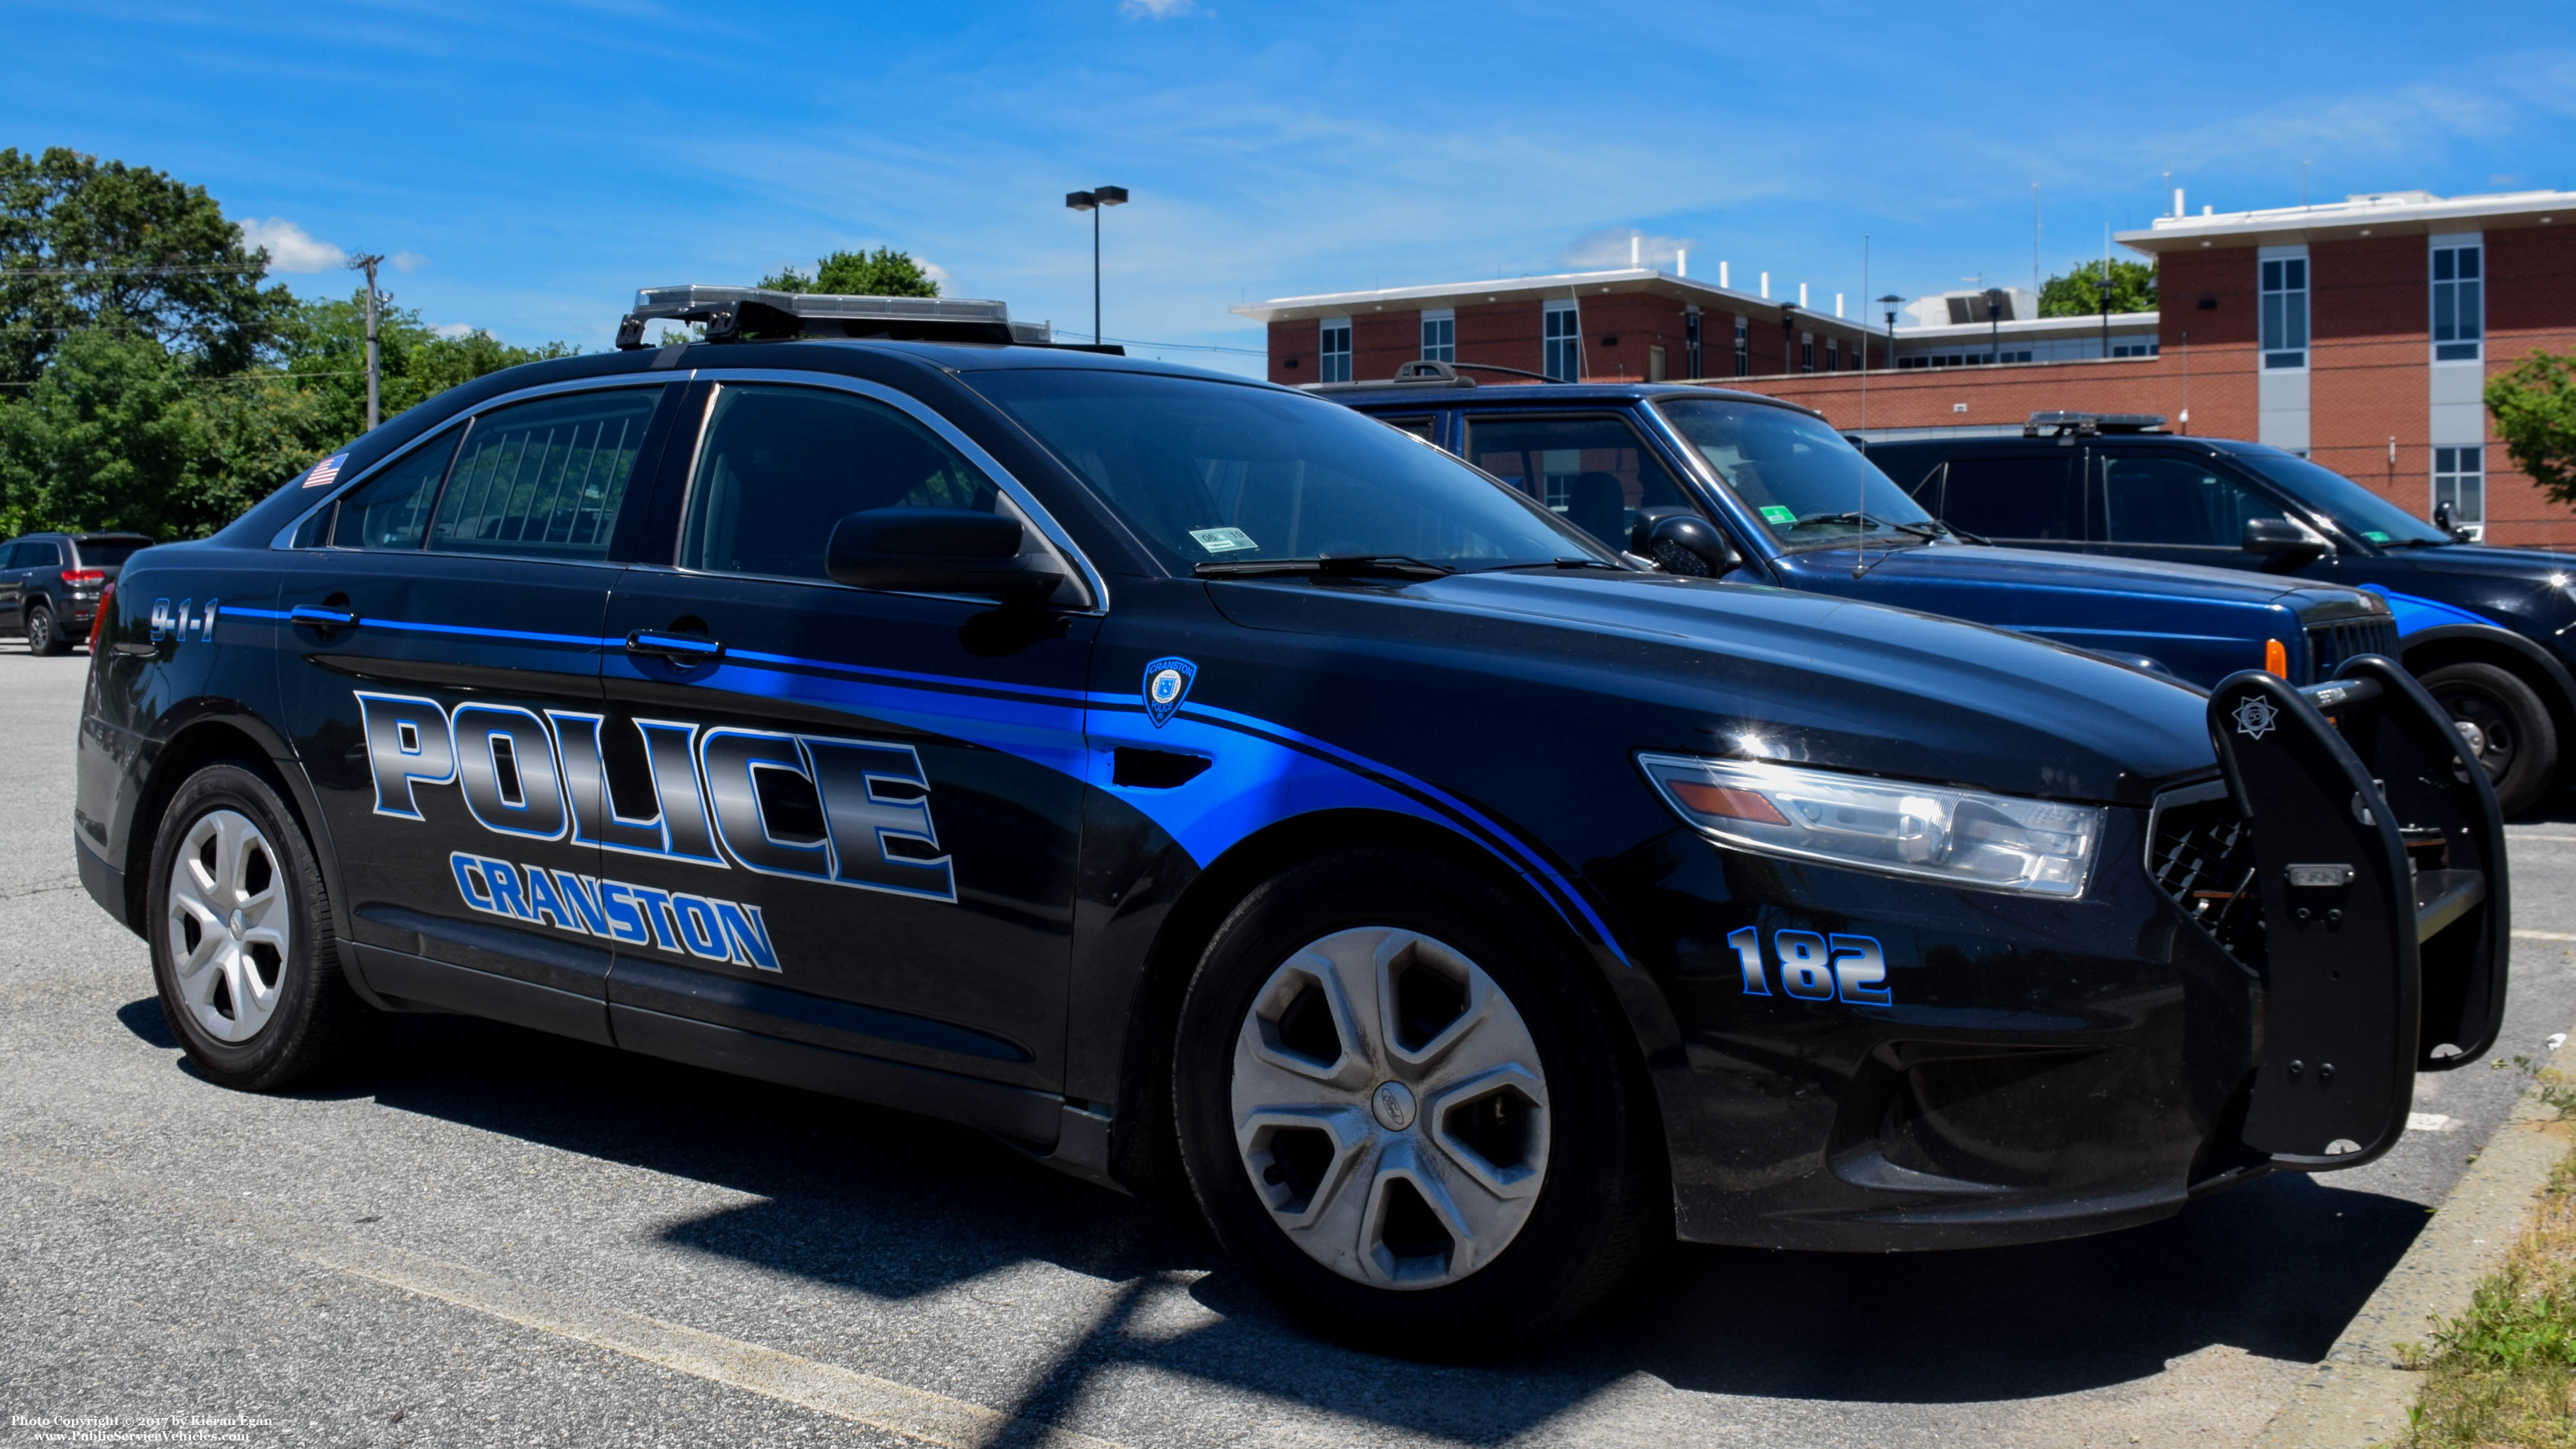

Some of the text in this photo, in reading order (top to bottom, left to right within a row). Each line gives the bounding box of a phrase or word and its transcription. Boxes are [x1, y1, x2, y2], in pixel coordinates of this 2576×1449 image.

[150, 598, 218, 642] 9-1-1
[1149, 661, 1193, 677] CRANSTON
[1151, 700, 1174, 713] POLICE
[353, 691, 957, 904] POLICE
[449, 851, 782, 973] CRANSTON
[1727, 926, 1892, 1006] 182
[1382, 1095, 1400, 1119] Ford
